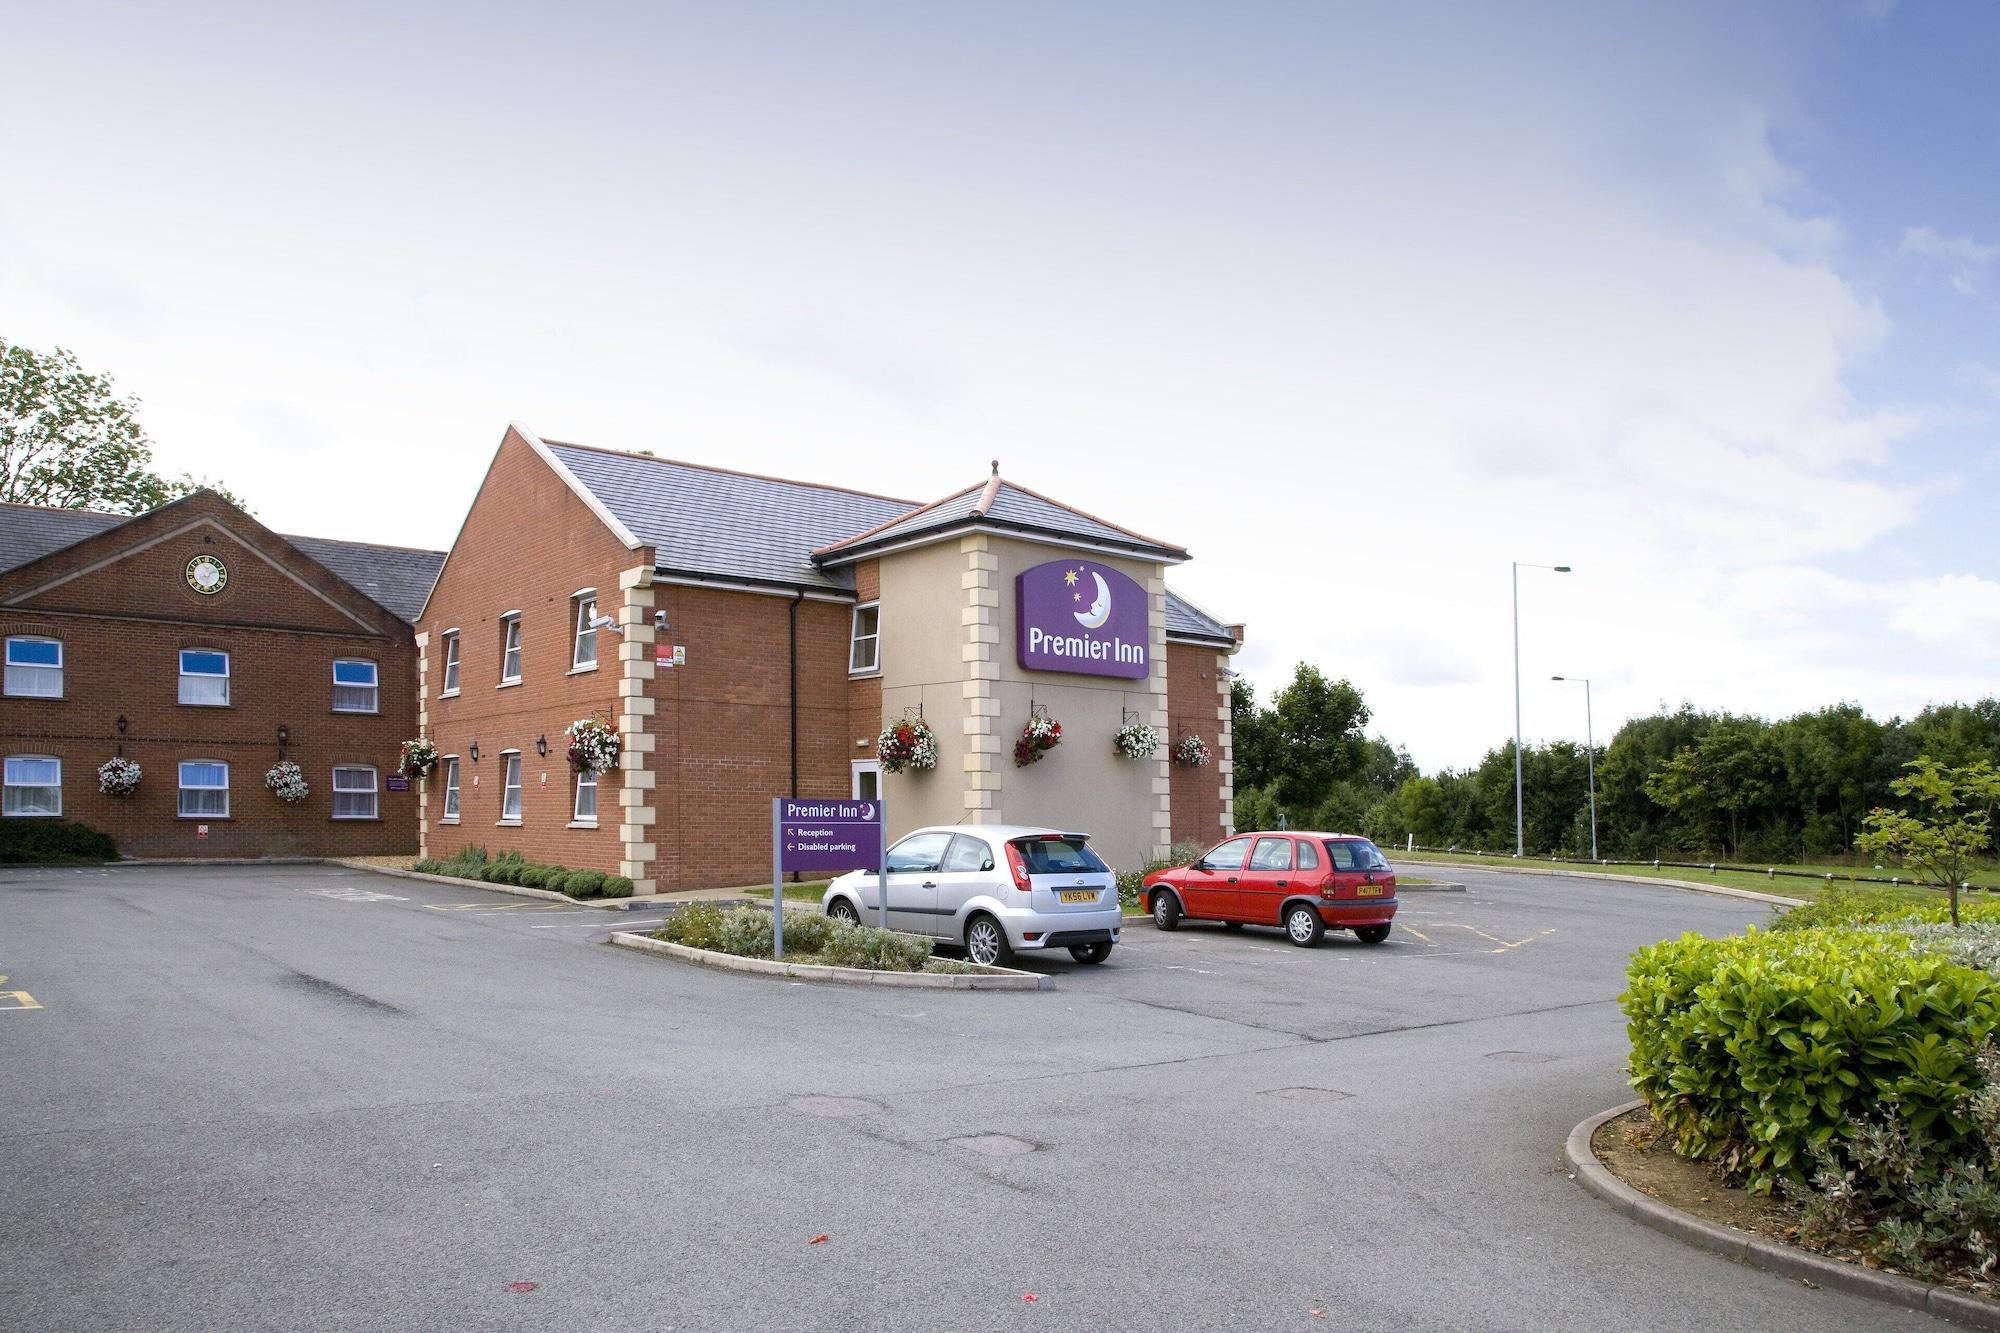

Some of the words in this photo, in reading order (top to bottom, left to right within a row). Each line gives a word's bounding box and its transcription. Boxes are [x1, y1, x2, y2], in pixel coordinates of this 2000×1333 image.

[1029, 627, 1111, 660] Premier
[1114, 637, 1144, 664] Inn
[787, 803, 836, 817] Premier
[839, 804, 858, 817] Inn
[797, 828, 834, 838] Reception
[797, 843, 829, 851] Disabled
[829, 843, 857, 853] parking
